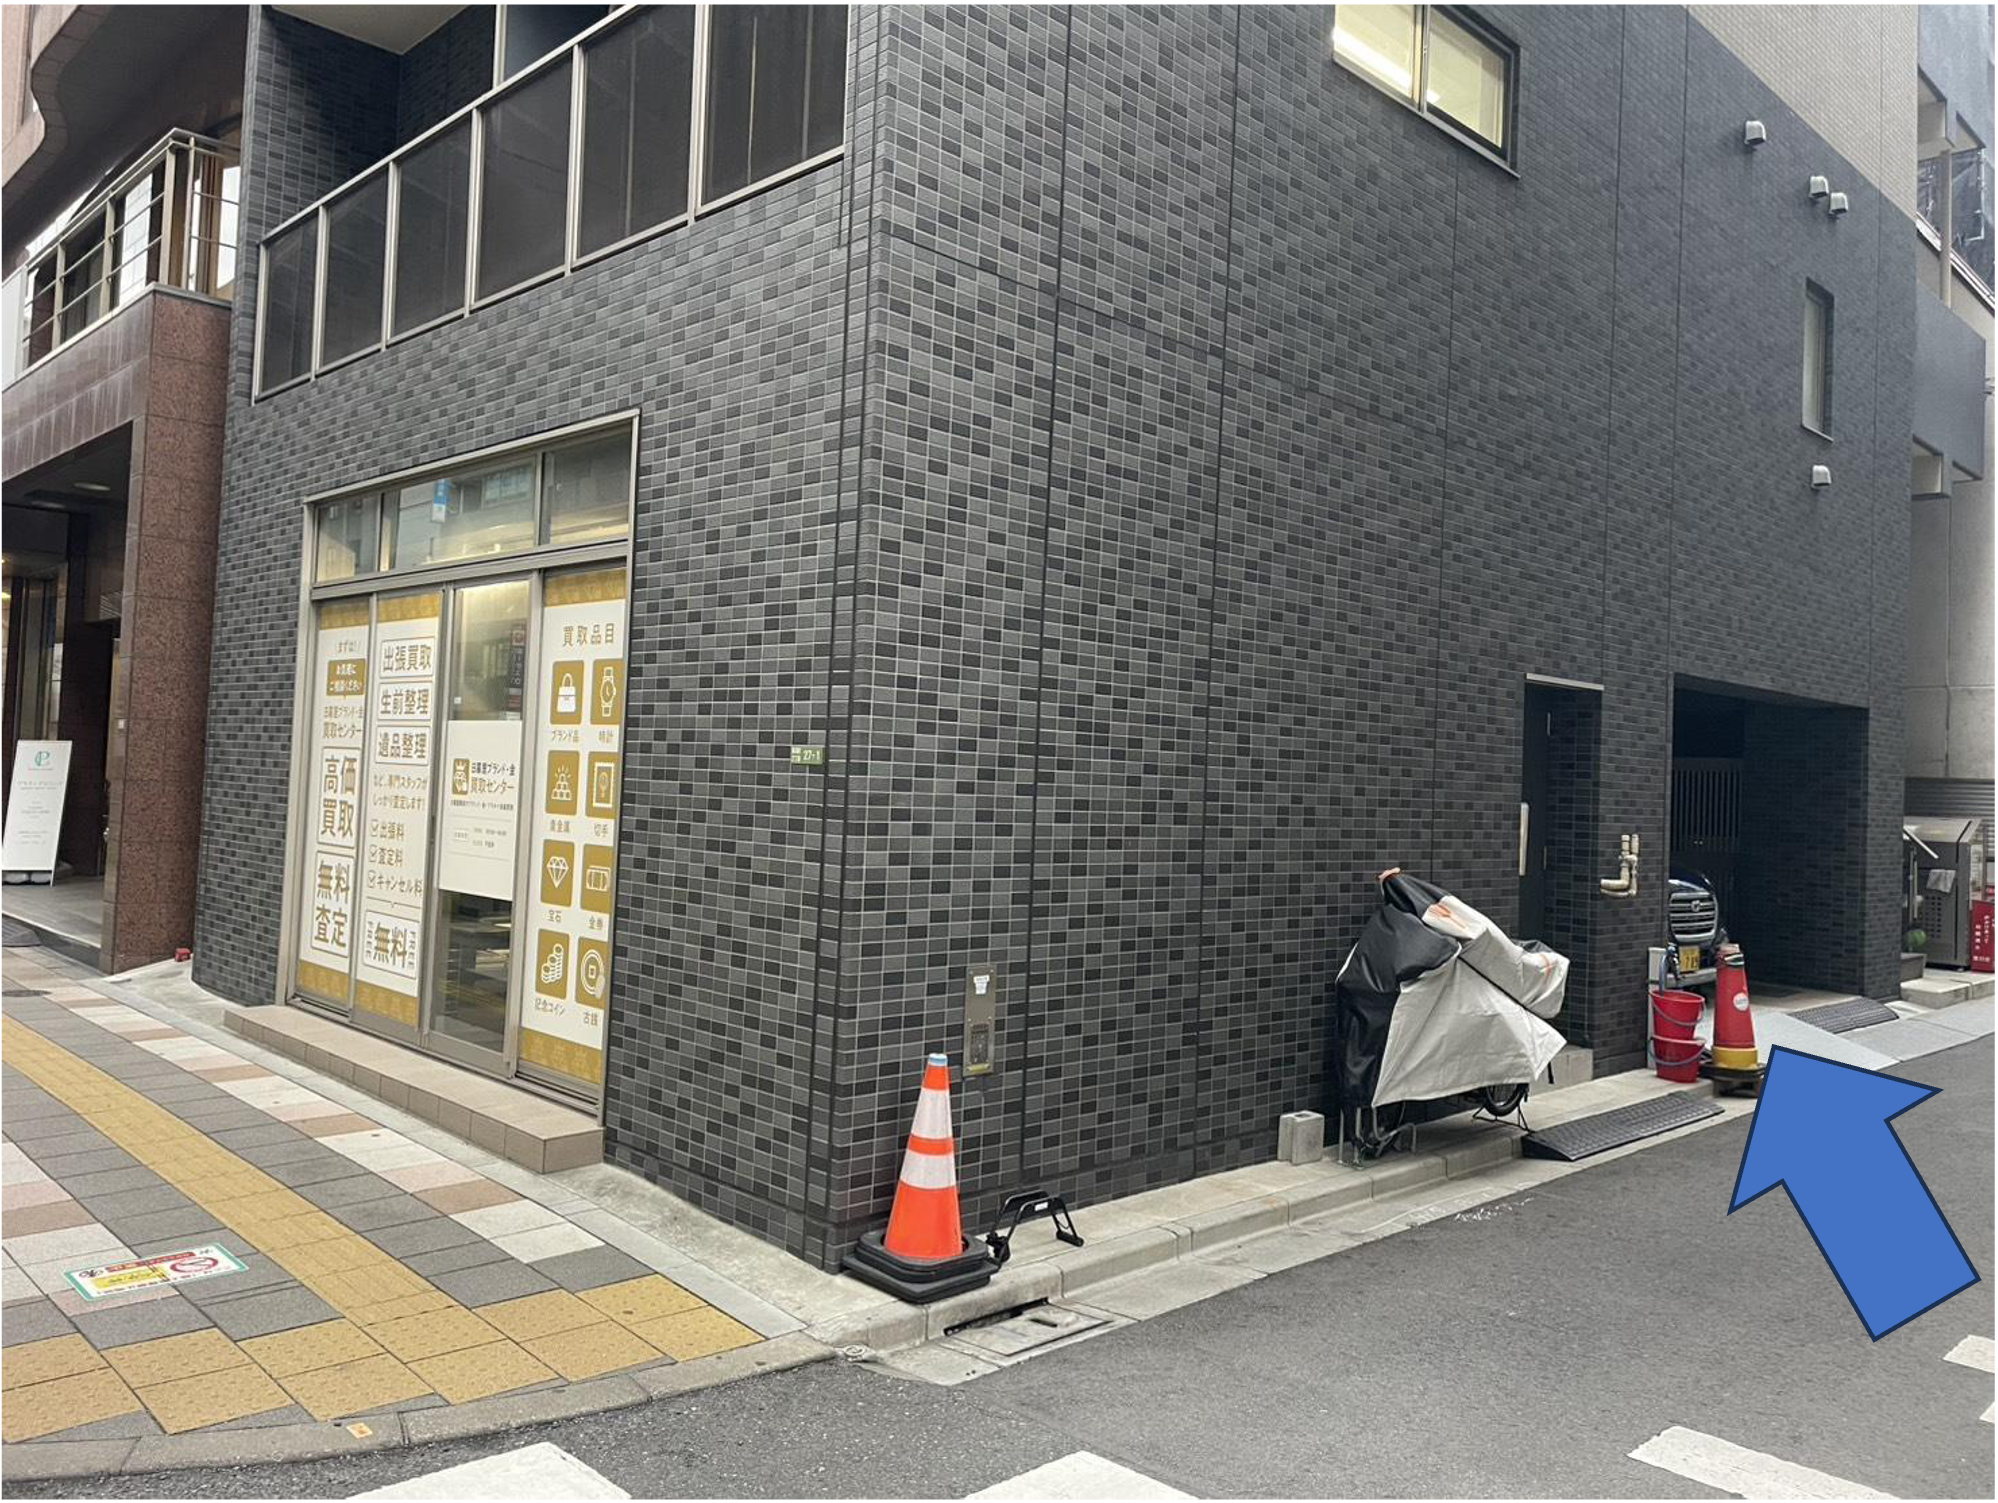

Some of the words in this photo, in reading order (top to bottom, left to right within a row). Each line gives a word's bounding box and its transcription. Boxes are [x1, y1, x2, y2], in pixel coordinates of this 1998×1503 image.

[563, 623, 614, 648] 買取品目
[382, 644, 432, 672] 出張買取
[380, 689, 429, 715] 生前整理
[378, 732, 426, 759] 遺品整理
[551, 730, 579, 743] ブランド品
[599, 730, 613, 744] 時計
[470, 777, 515, 795] 買取センター
[594, 822, 608, 838] 切手
[378, 847, 403, 868] 査定料
[377, 874, 423, 897] キャンセル料
[548, 909, 562, 923] 宝石
[373, 922, 407, 968] 無料
